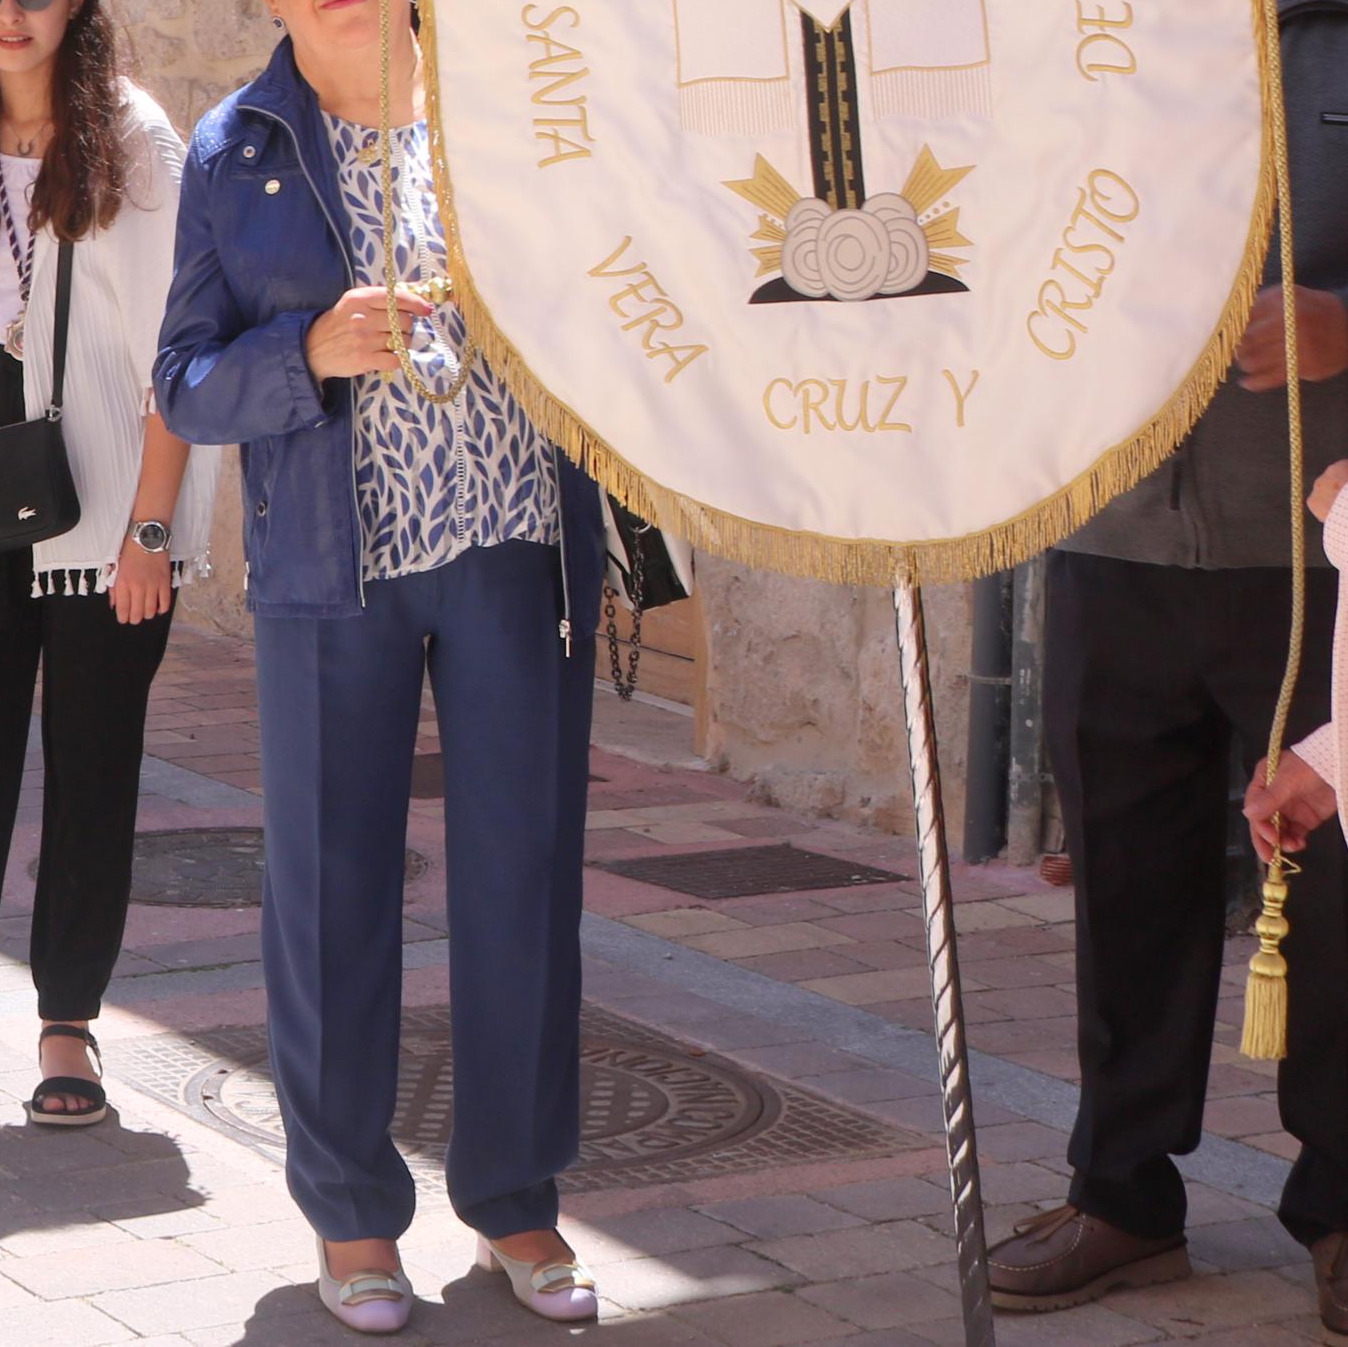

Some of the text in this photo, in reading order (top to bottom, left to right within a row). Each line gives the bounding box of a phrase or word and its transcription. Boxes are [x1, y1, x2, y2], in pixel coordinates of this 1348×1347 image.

[520, 3, 596, 169] SANTA
[586, 235, 709, 383] VERA
[762, 374, 912, 434] CRUZ
[941, 369, 980, 428] Y
[1026, 168, 1140, 360] CRISTO
